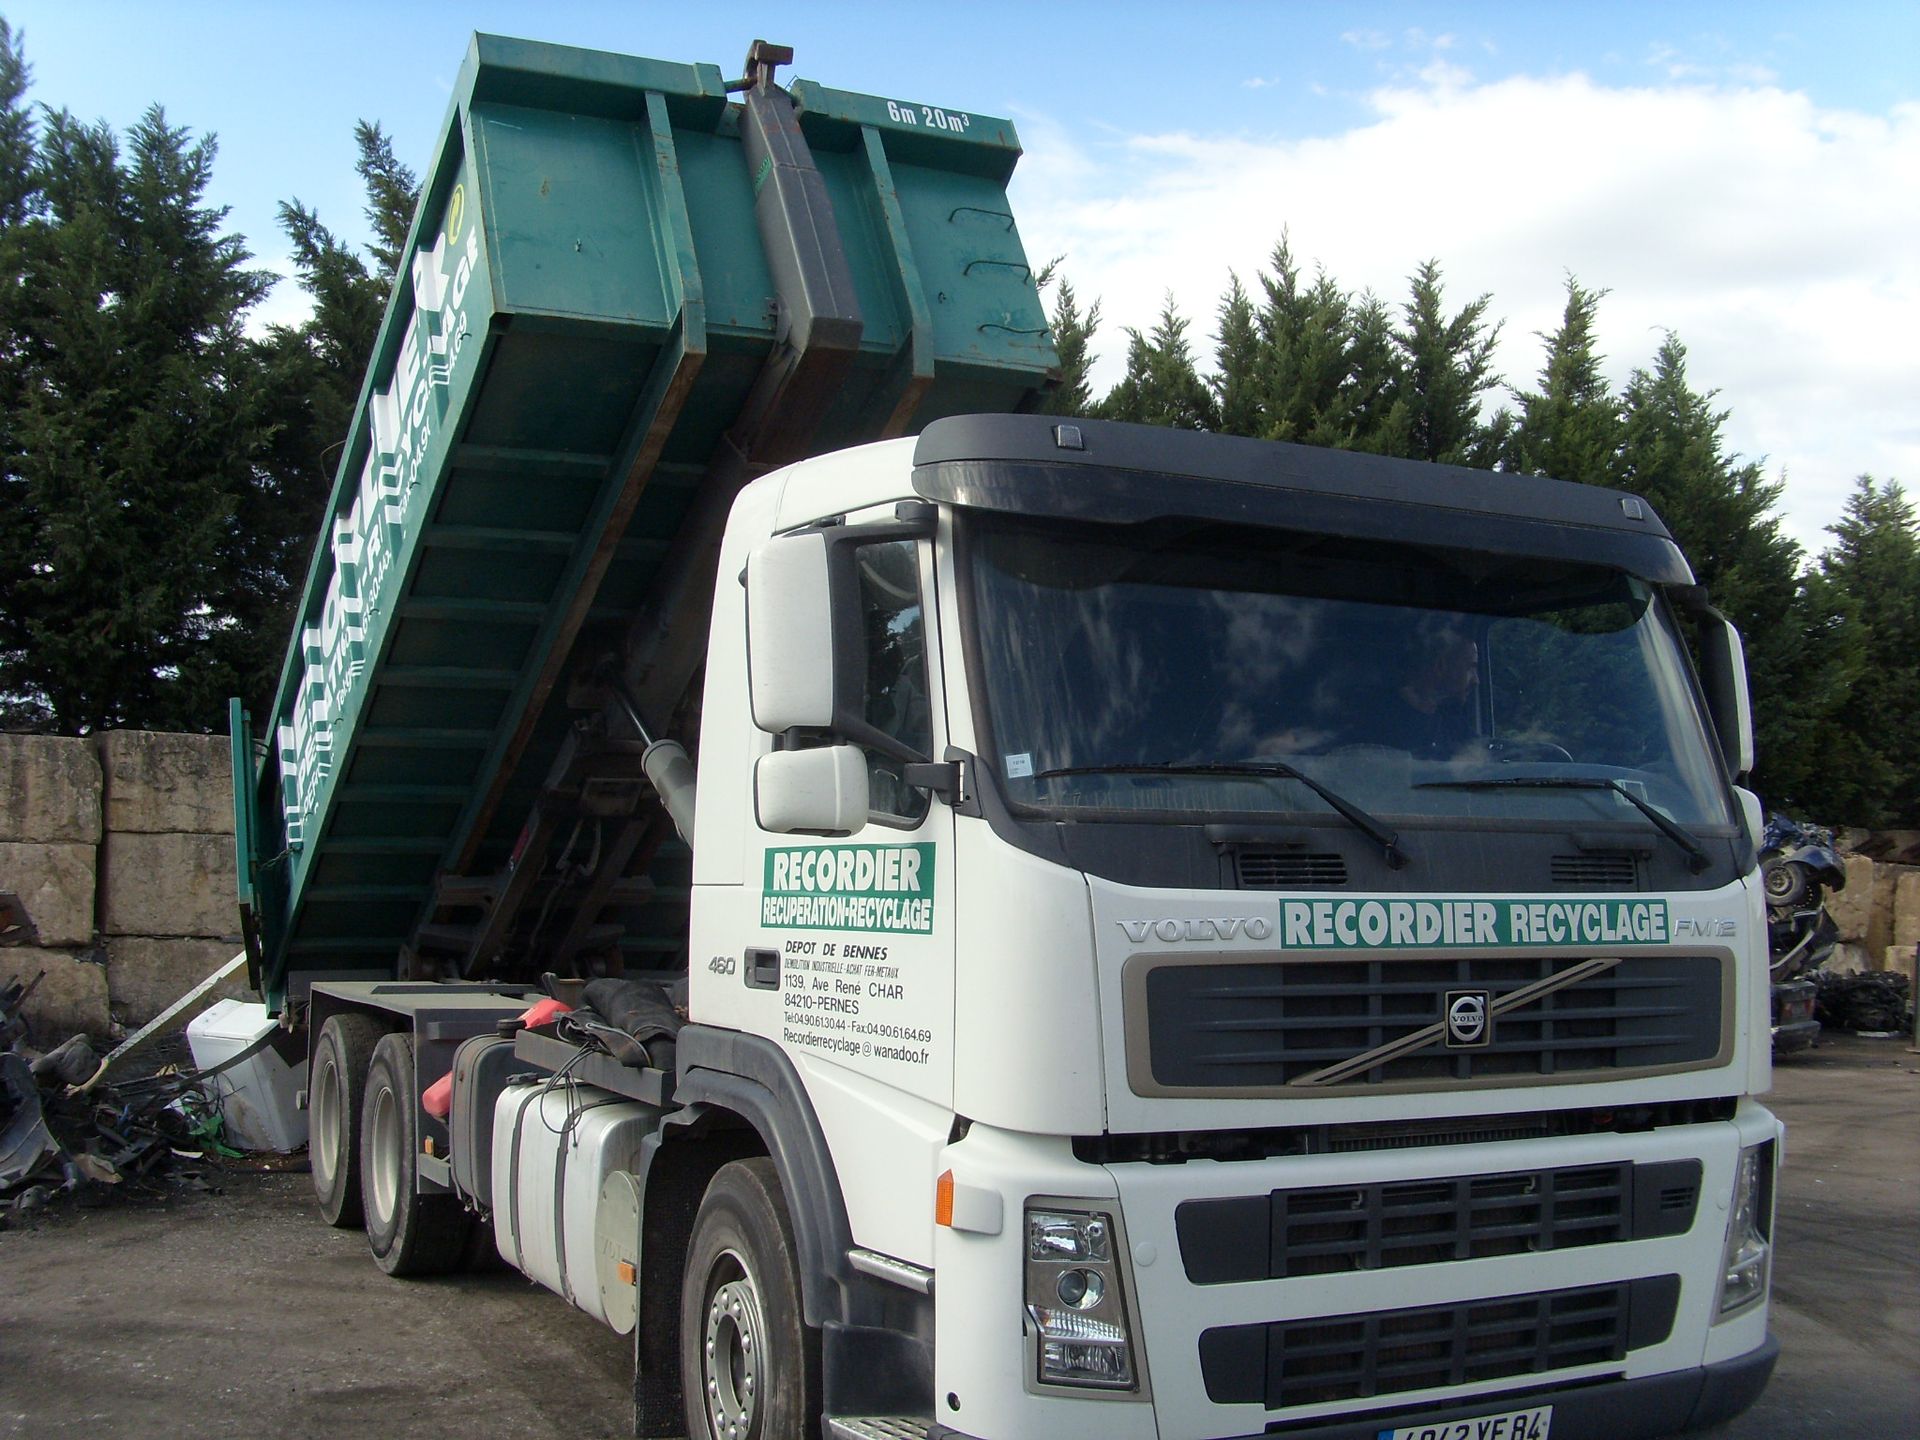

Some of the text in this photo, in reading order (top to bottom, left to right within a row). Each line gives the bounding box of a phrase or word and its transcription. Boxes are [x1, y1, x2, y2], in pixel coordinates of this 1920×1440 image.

[887, 101, 917, 125] 6m
[773, 848, 921, 892] RECORDIER
[762, 896, 932, 931] RECUPERATION-RECYCLAGE
[1284, 901, 1666, 946] RECORDIER RECYCLAGE
[1116, 916, 1273, 943] VOLVO
[1674, 918, 1736, 937] FM12
[785, 940, 888, 961] DEPOT DE BENNES
[708, 956, 736, 975] 460
[812, 976, 829, 992] Ave
[835, 979, 861, 996] René
[868, 982, 904, 1000] CHAR
[784, 993, 860, 1015] 84210-PERNES
[783, 1027, 861, 1057] Recordierrecyclage
[873, 1045, 930, 1065] wanadoo.fr
[1511, 1411, 1541, 1440] 84
